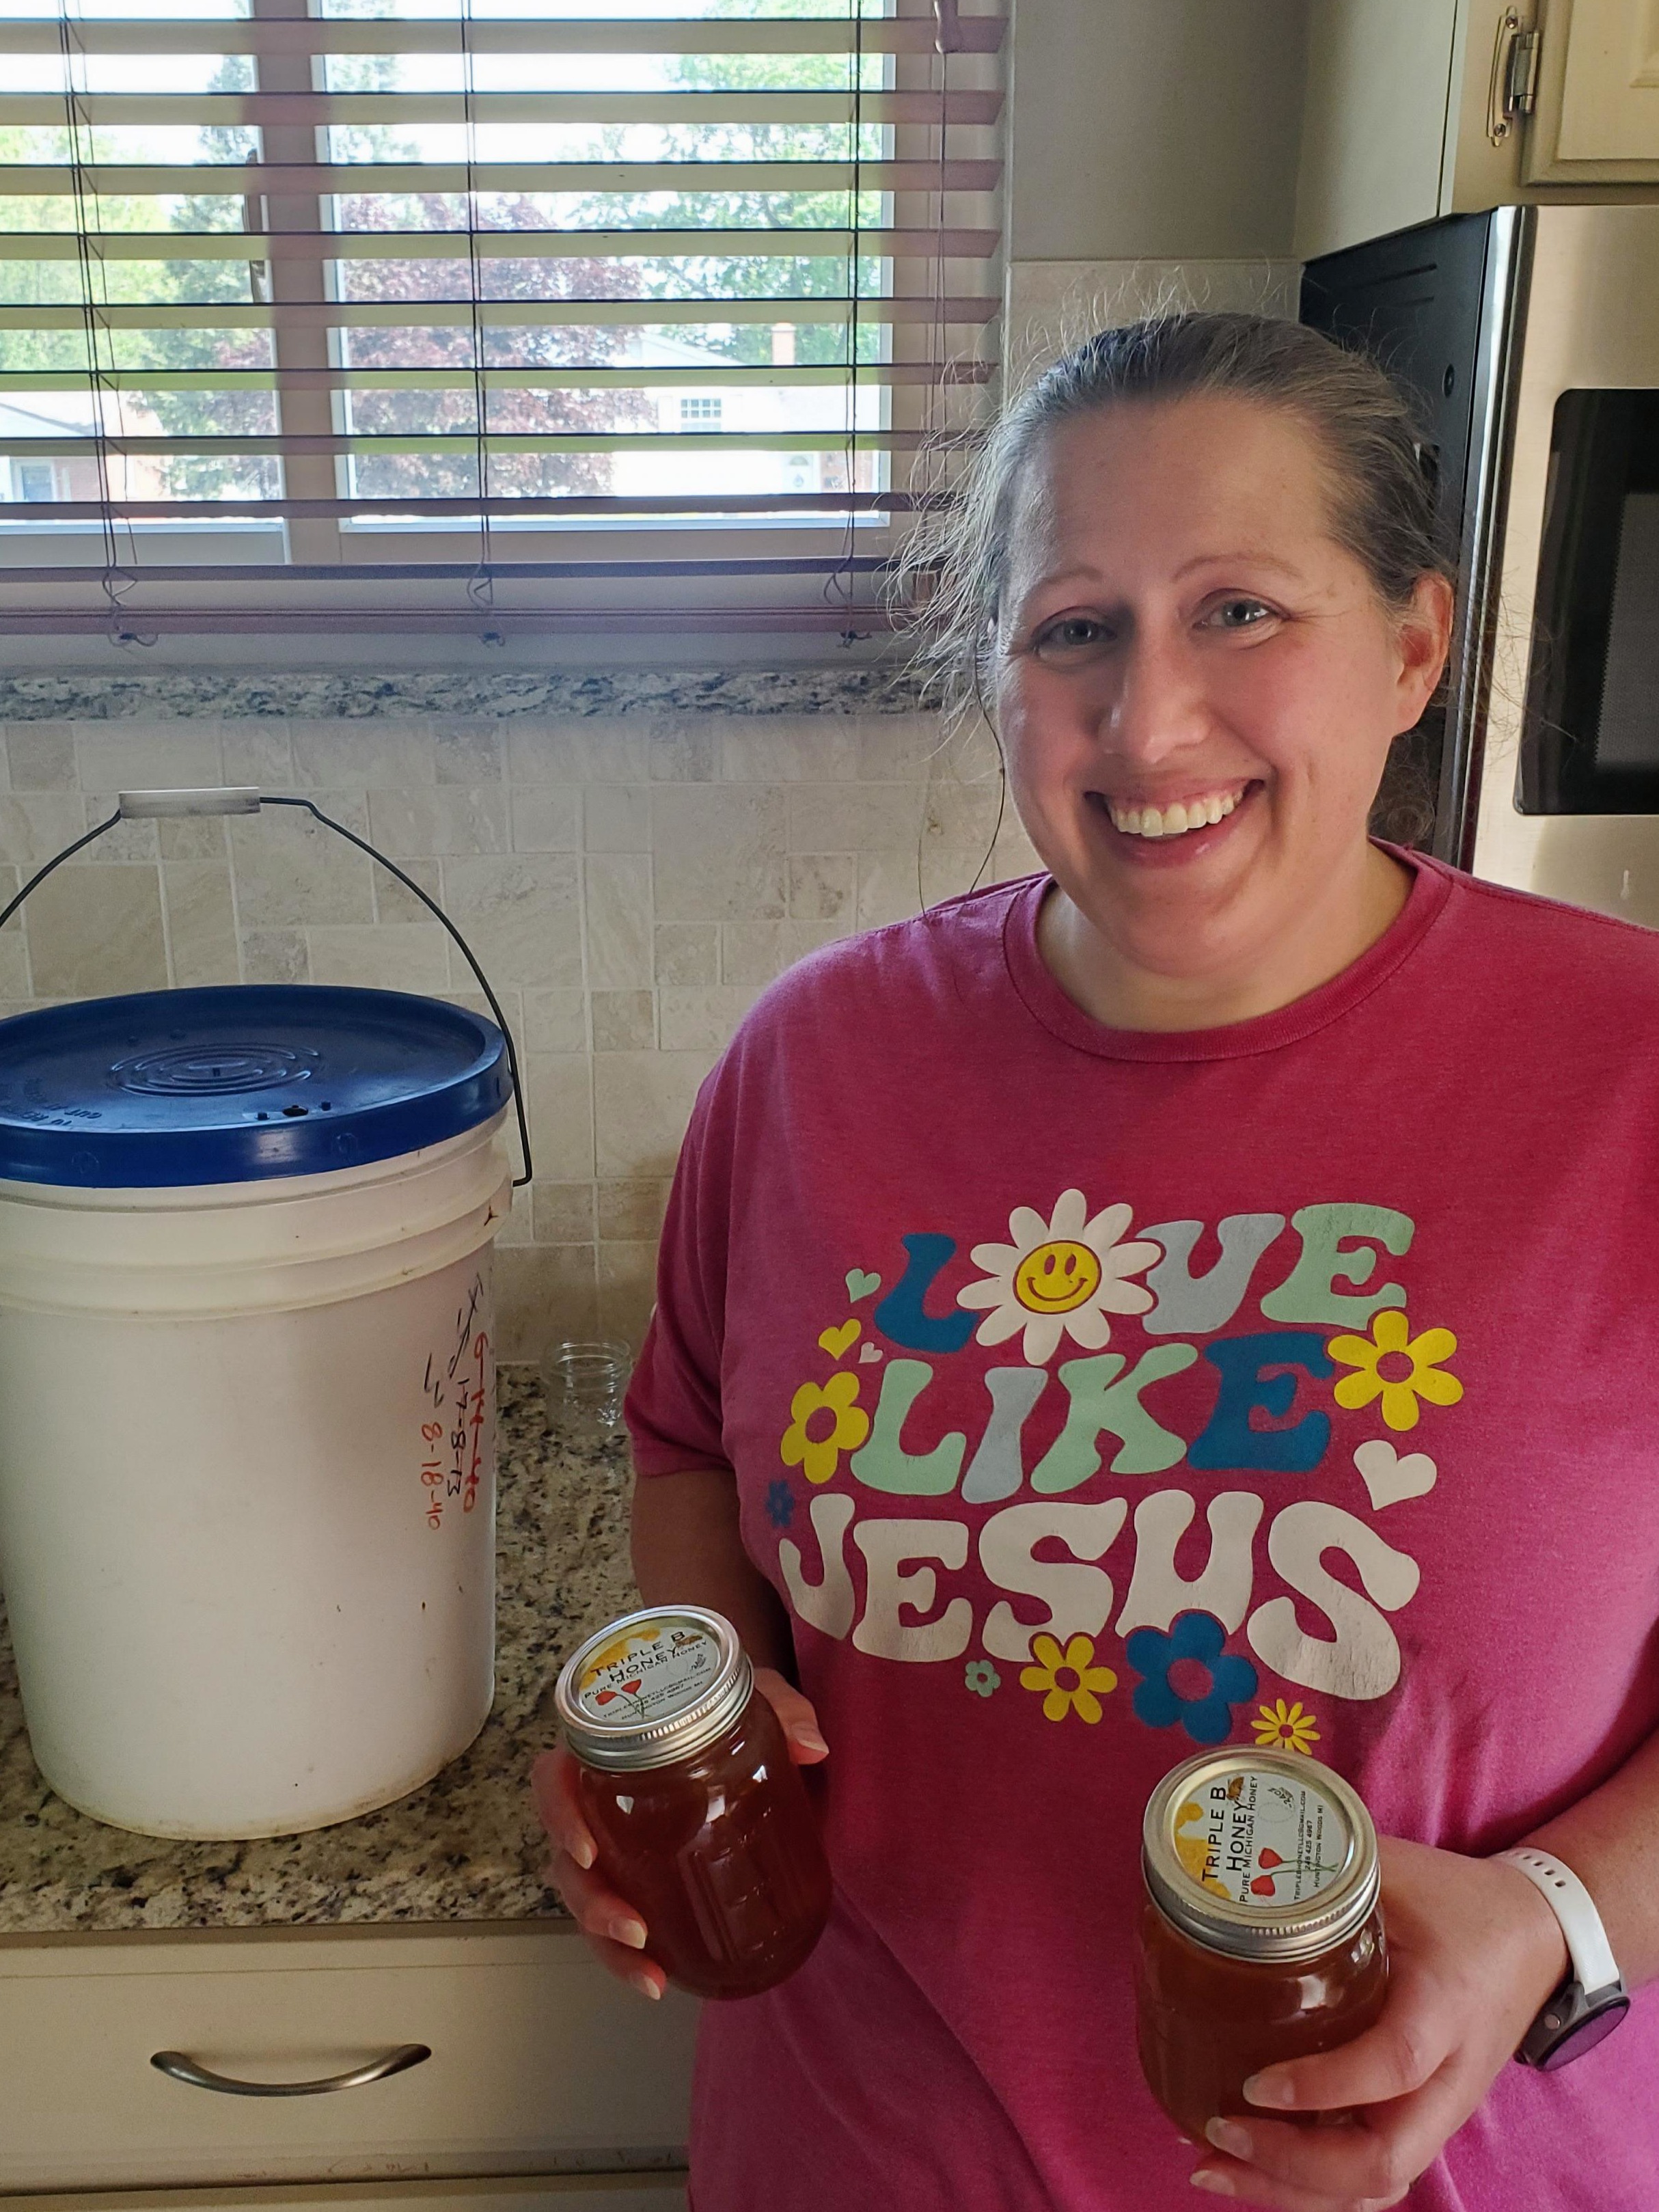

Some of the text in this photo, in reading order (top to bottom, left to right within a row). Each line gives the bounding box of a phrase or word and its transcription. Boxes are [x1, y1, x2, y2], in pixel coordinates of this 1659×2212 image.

[850, 1331, 1335, 1504] LIKE
[778, 1488, 1420, 1701] JESUS
[584, 1684, 612, 1699] PURE
[672, 1641, 708, 1659] HONEY
[590, 1630, 685, 1677] TRIPLE B
[609, 1646, 679, 1682] HONEY
[1202, 1786, 1226, 1881] TRIPLE B
[1226, 1799, 1248, 1872] HONEY
[1239, 1776, 1259, 1902] PURE MICHIGAN HONEY
